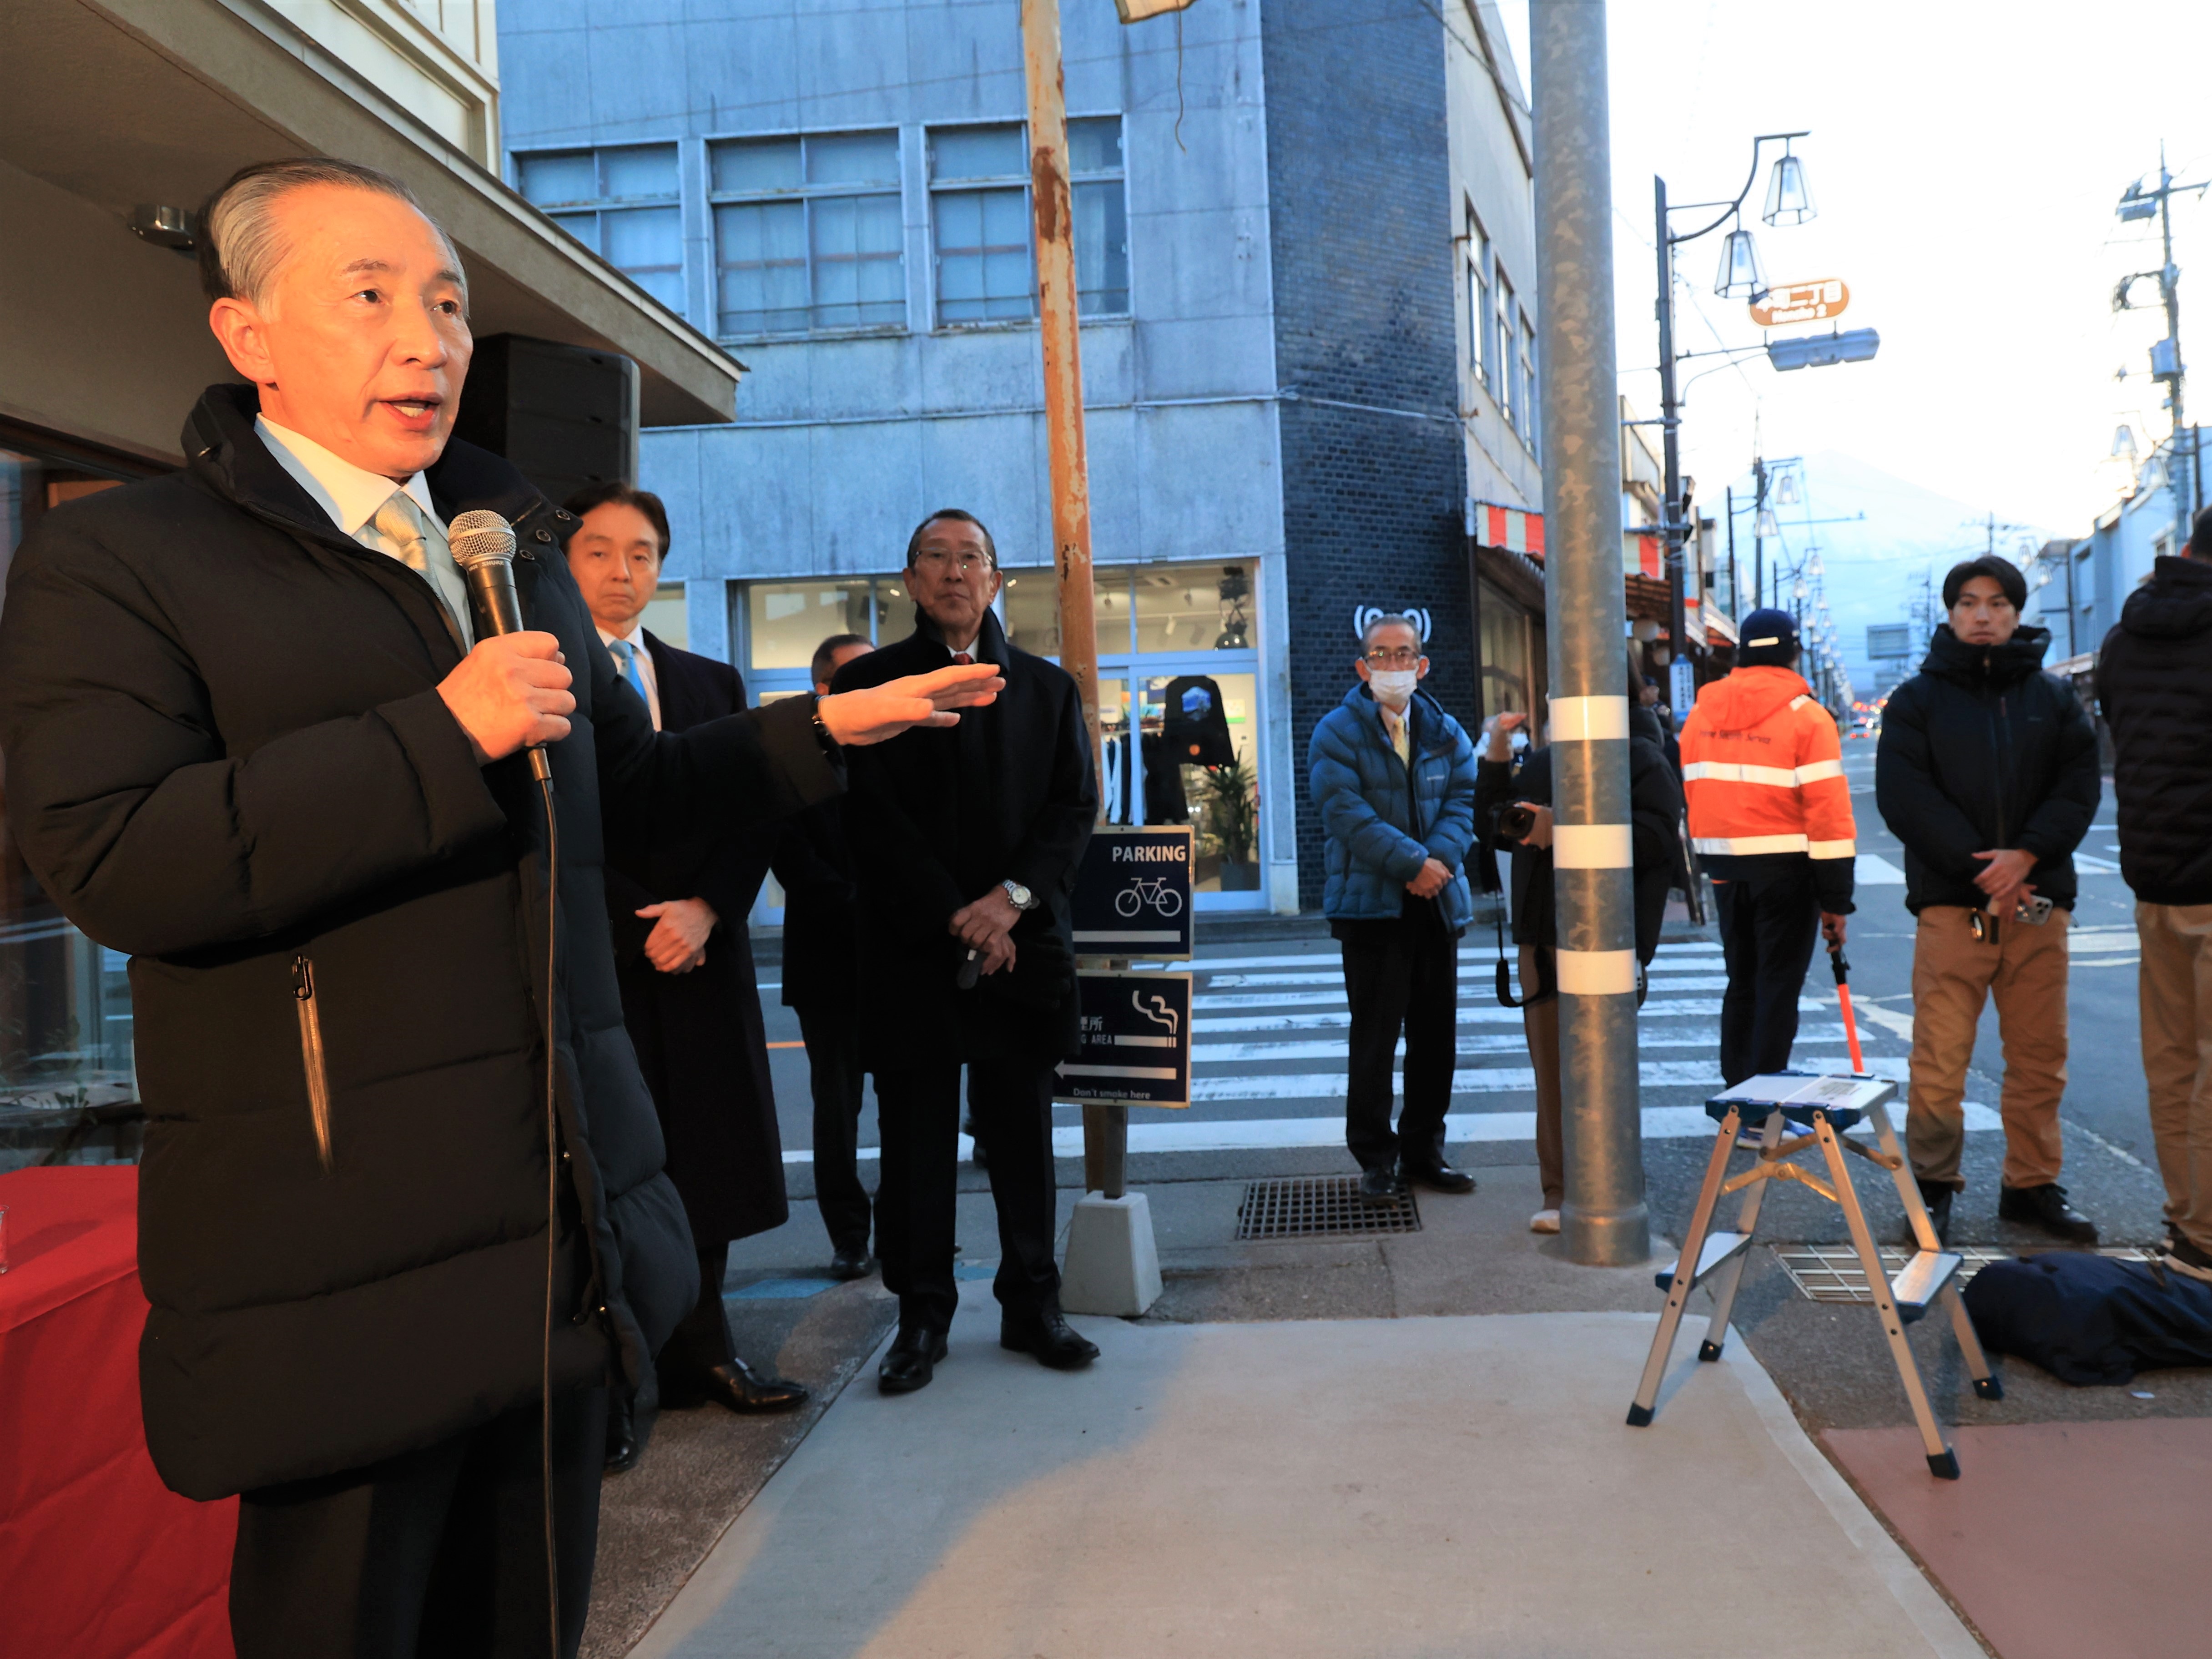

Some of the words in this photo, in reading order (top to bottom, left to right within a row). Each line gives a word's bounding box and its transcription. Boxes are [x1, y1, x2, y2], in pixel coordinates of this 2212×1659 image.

[1817, 303, 1827, 318] 2
[1112, 845, 1186, 862] PARKING
[1091, 1034, 1113, 1045] AREA
[1073, 1088, 1097, 1097] Don't
[1100, 1090, 1128, 1099] smoke
[1130, 1090, 1151, 1099] here
